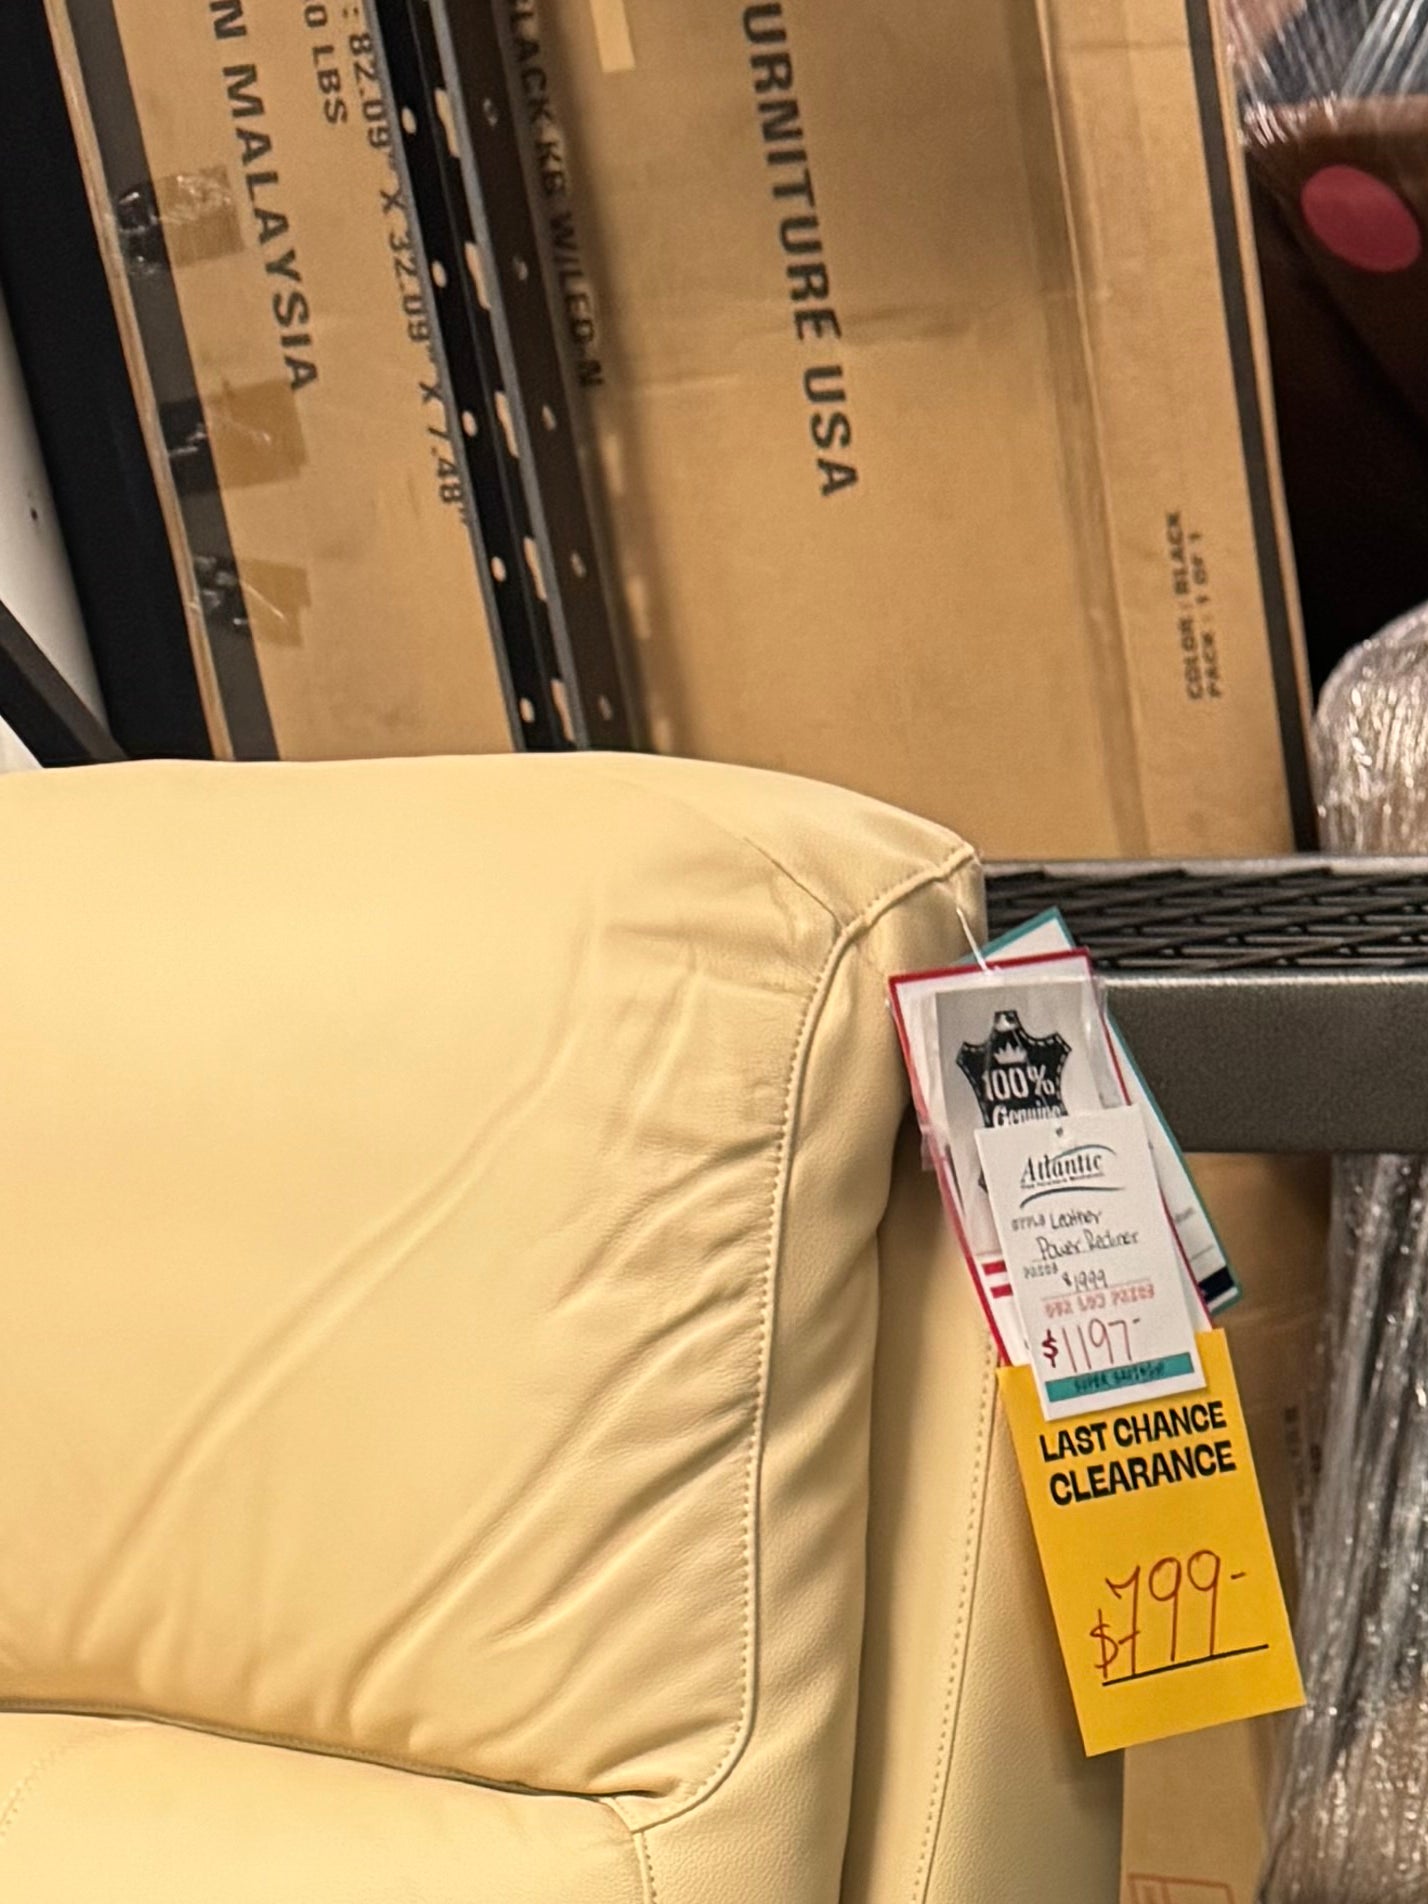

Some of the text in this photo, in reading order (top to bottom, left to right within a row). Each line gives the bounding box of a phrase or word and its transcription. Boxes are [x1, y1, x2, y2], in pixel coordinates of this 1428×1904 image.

[304, 3, 348, 125] 0 LBS
[508, 0, 554, 124] LACK
[209, 0, 319, 391] N MALAYSIA
[741, 2, 860, 498] URNITURE USA
[1166, 510, 1205, 701] COLOR BLACK
[1202, 630, 1222, 699] PACK
[982, 1064, 1056, 1102] 100%
[1019, 1152, 1103, 1185] Atlantic
[1036, 1235, 1081, 1261] Power
[1039, 1400, 1227, 1463] LAST CHANCE
[1049, 1440, 1238, 1506] CLEARANCE
